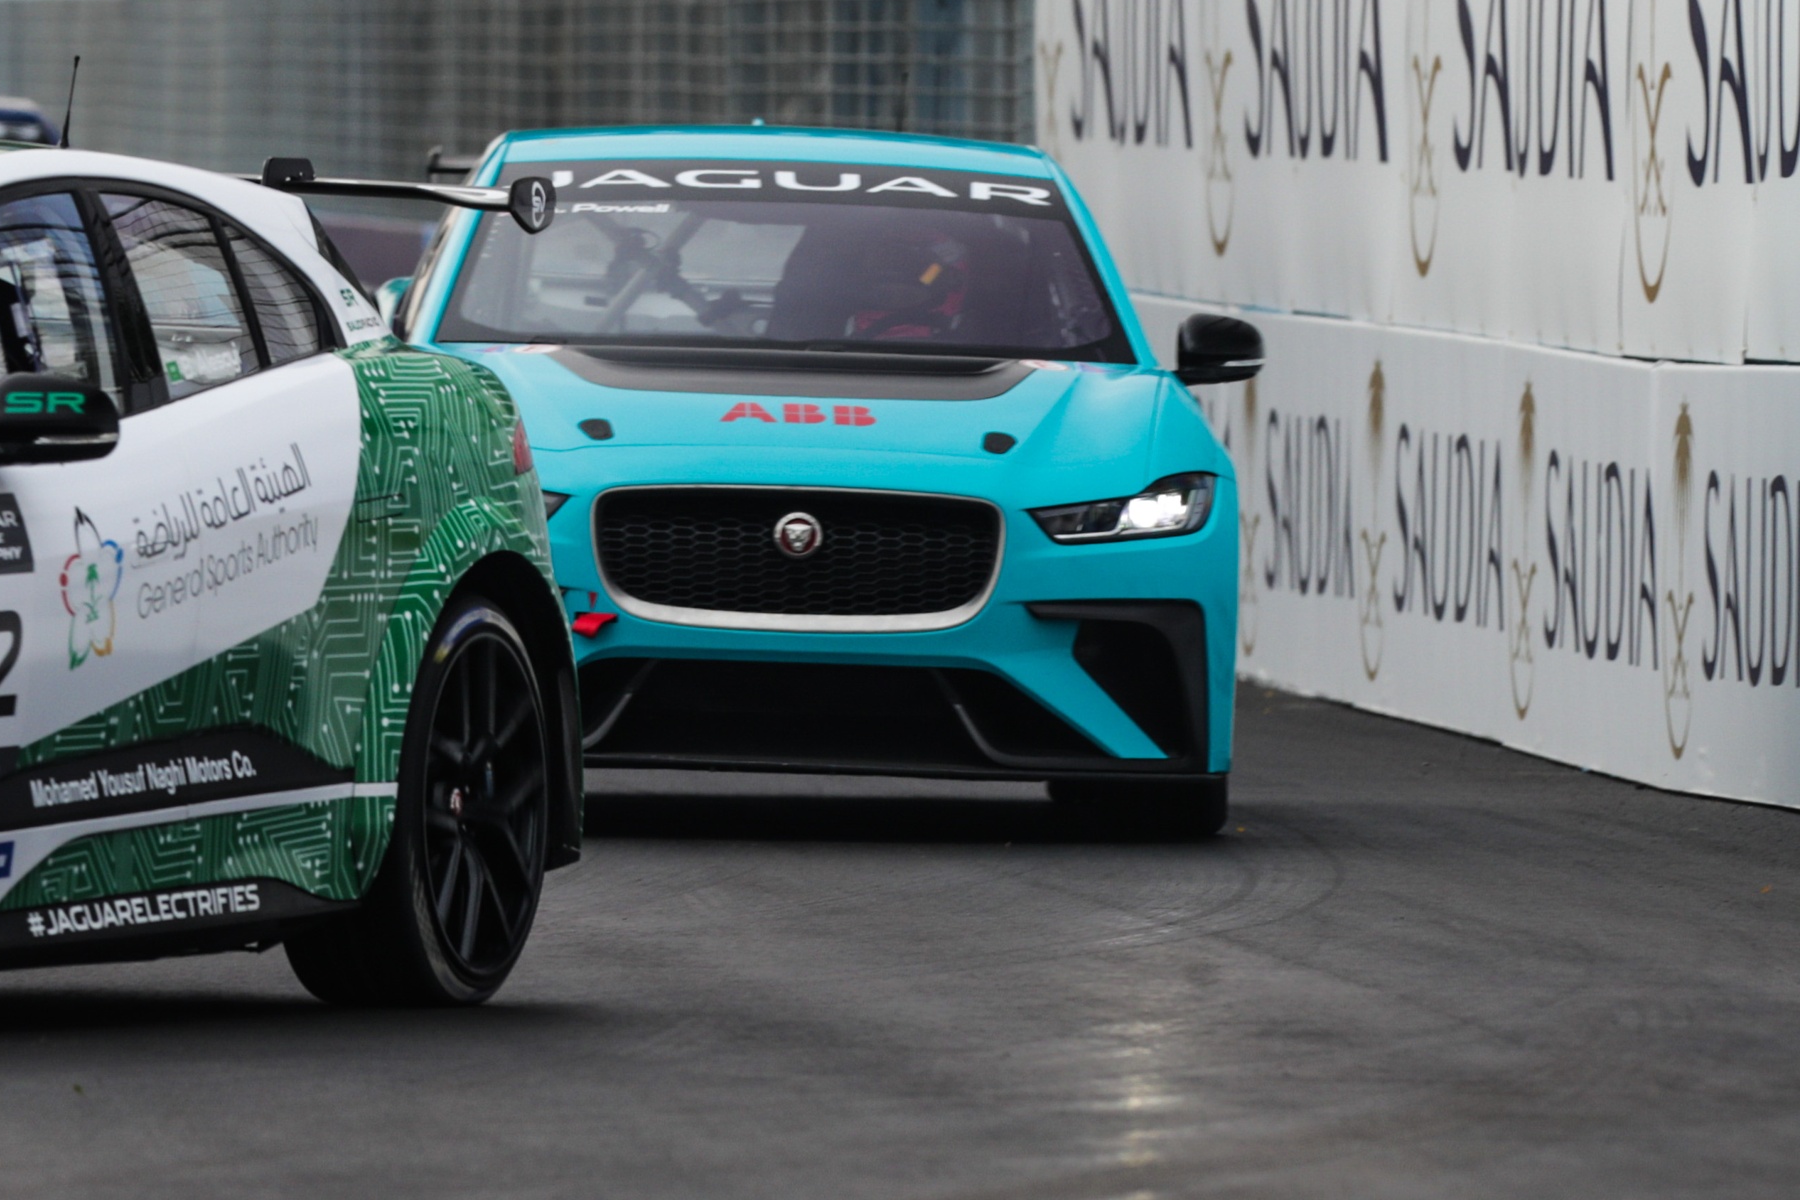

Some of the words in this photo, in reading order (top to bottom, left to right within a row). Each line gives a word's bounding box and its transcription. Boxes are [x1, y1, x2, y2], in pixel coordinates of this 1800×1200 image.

[571, 202, 671, 214] Powell
[3, 391, 87, 414] SR
[720, 401, 877, 428] ABB
[1265, 408, 1355, 598] SAUDIA
[1393, 422, 1504, 632] SAUDIA
[137, 563, 205, 620] General
[206, 543, 253, 597] Sports
[256, 512, 319, 569] Authority
[1544, 448, 1659, 671] SAUDIA
[29, 772, 99, 809] Mohamed
[98, 763, 146, 798] Yousuf
[147, 757, 186, 796] Naghi
[186, 755, 233, 786] Motors
[232, 749, 257, 778] Co.
[26, 884, 261, 938] #JAGUARELECTRIFIES
